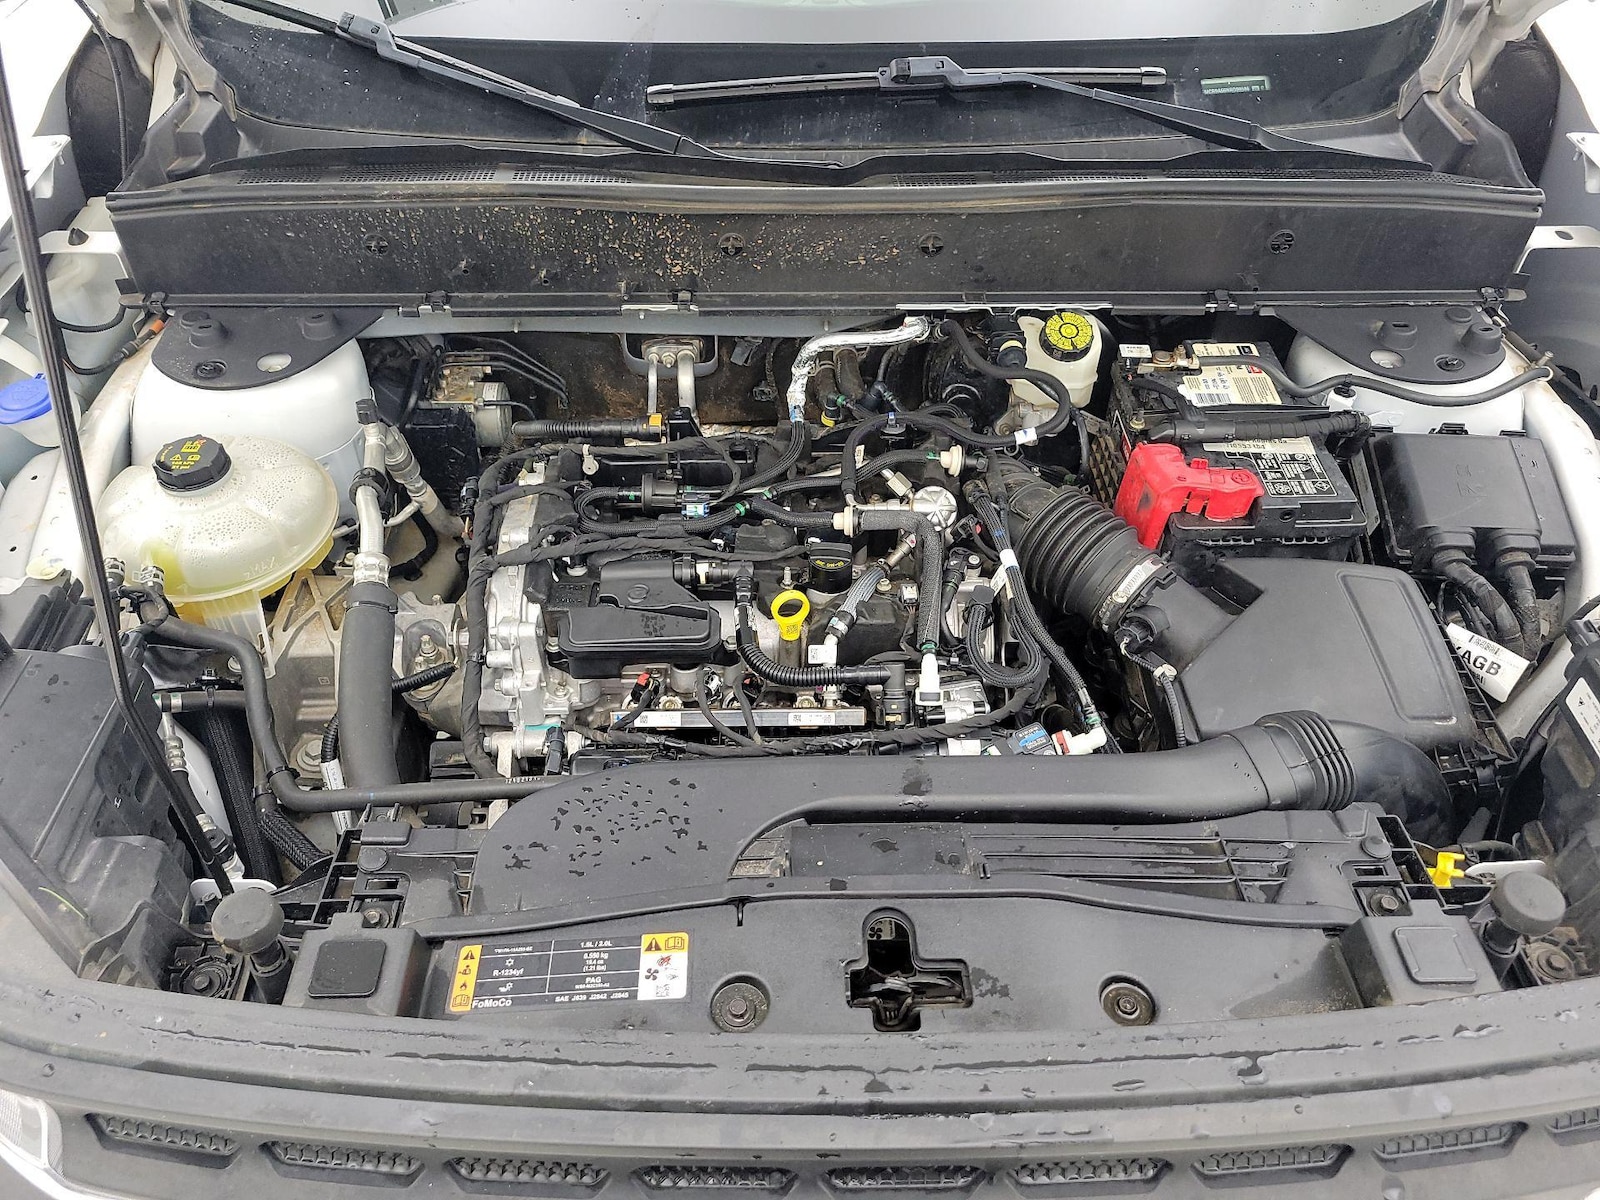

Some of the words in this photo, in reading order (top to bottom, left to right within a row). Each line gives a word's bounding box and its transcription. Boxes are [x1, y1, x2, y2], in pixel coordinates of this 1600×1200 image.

[492, 968, 524, 977] R-1234yf
[585, 976, 602, 984] PAG
[472, 998, 513, 1009] FoMoCo
